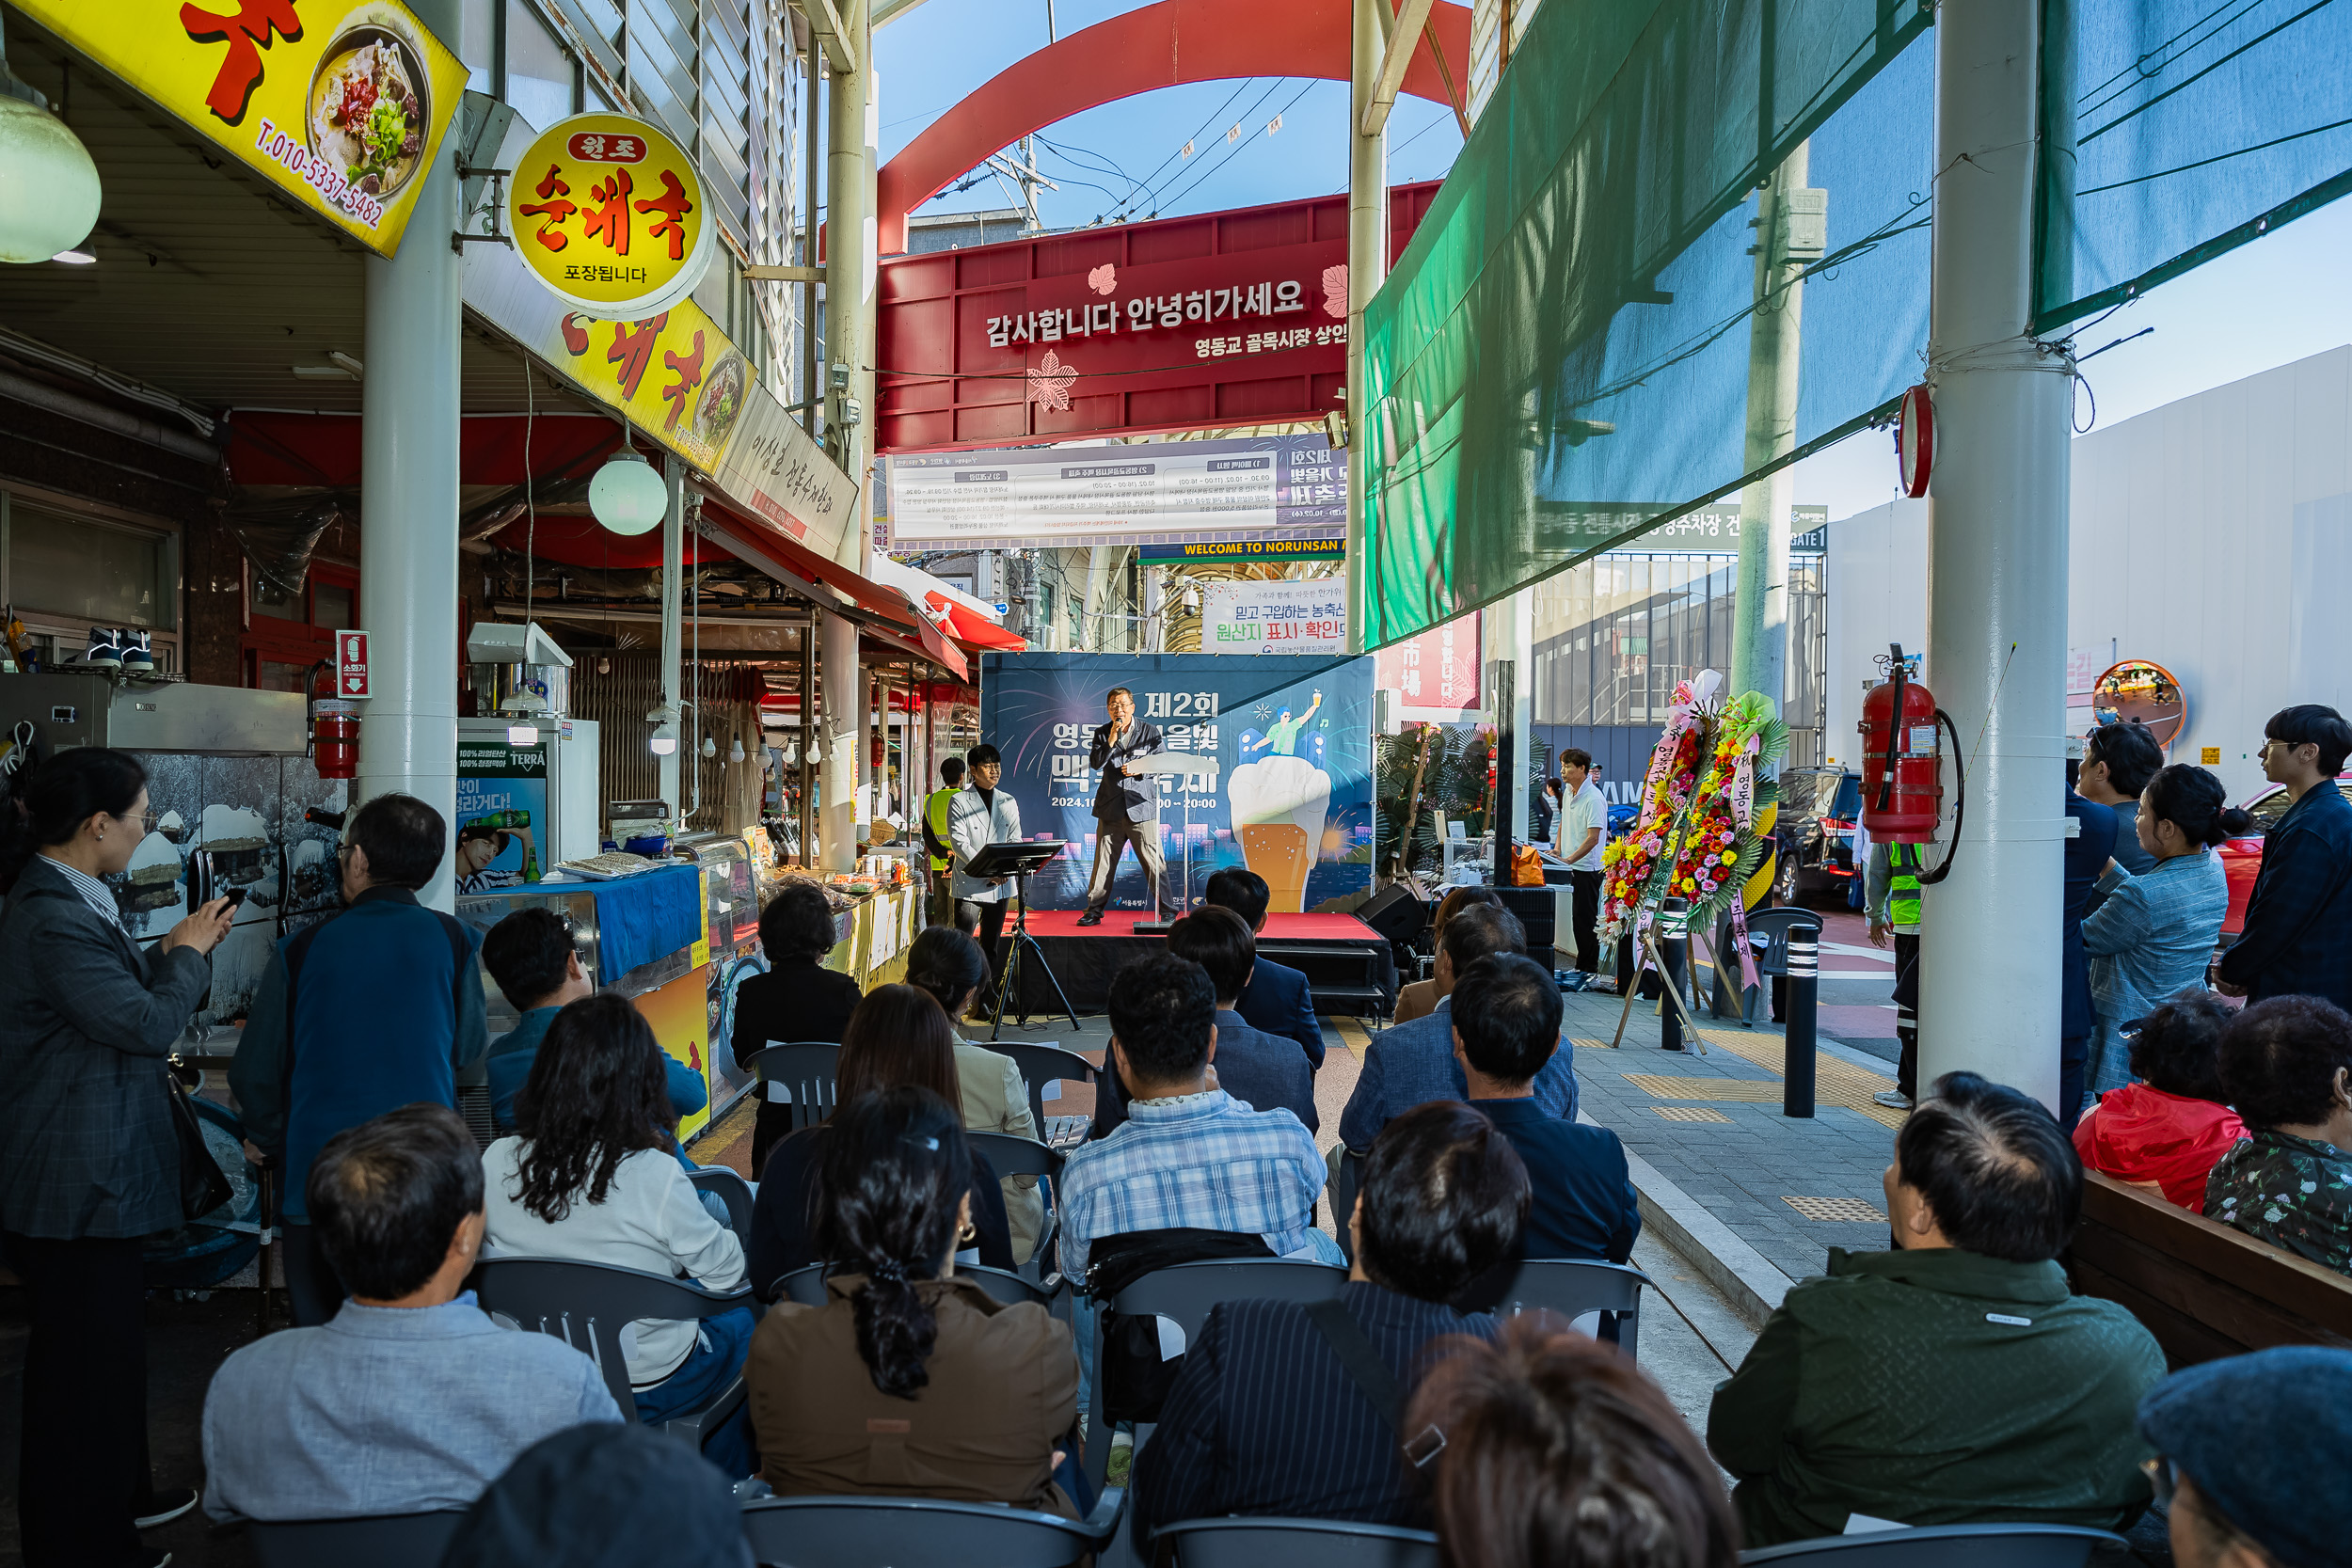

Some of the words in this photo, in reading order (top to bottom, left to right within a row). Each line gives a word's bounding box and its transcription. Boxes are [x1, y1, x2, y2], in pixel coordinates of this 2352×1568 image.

[580, 135, 637, 160] 원조
[258, 119, 384, 230] T.010-5337-5482
[519, 163, 693, 261] 순대국
[564, 264, 647, 283] 포장됩니다
[987, 300, 1120, 348] 감사합니다
[1128, 279, 1305, 332] 안녕히가세요
[1195, 336, 1242, 357] 영동교
[1246, 327, 1311, 354] 골목시장
[1184, 543, 1243, 555] WELCOME
[1246, 542, 1263, 553] TO
[1265, 540, 1339, 553] NORUNSAN
[1790, 531, 1817, 546] GATE
[1818, 527, 1825, 546] 1
[1235, 606, 1259, 620] 믿고
[1262, 604, 1309, 620] 구입하는
[1216, 623, 1261, 641] 원산지
[342, 664, 366, 673] 소화기
[1144, 691, 1219, 718] 제2회
[510, 751, 546, 766] TERRA
[1737, 773, 1751, 825] 영동교
